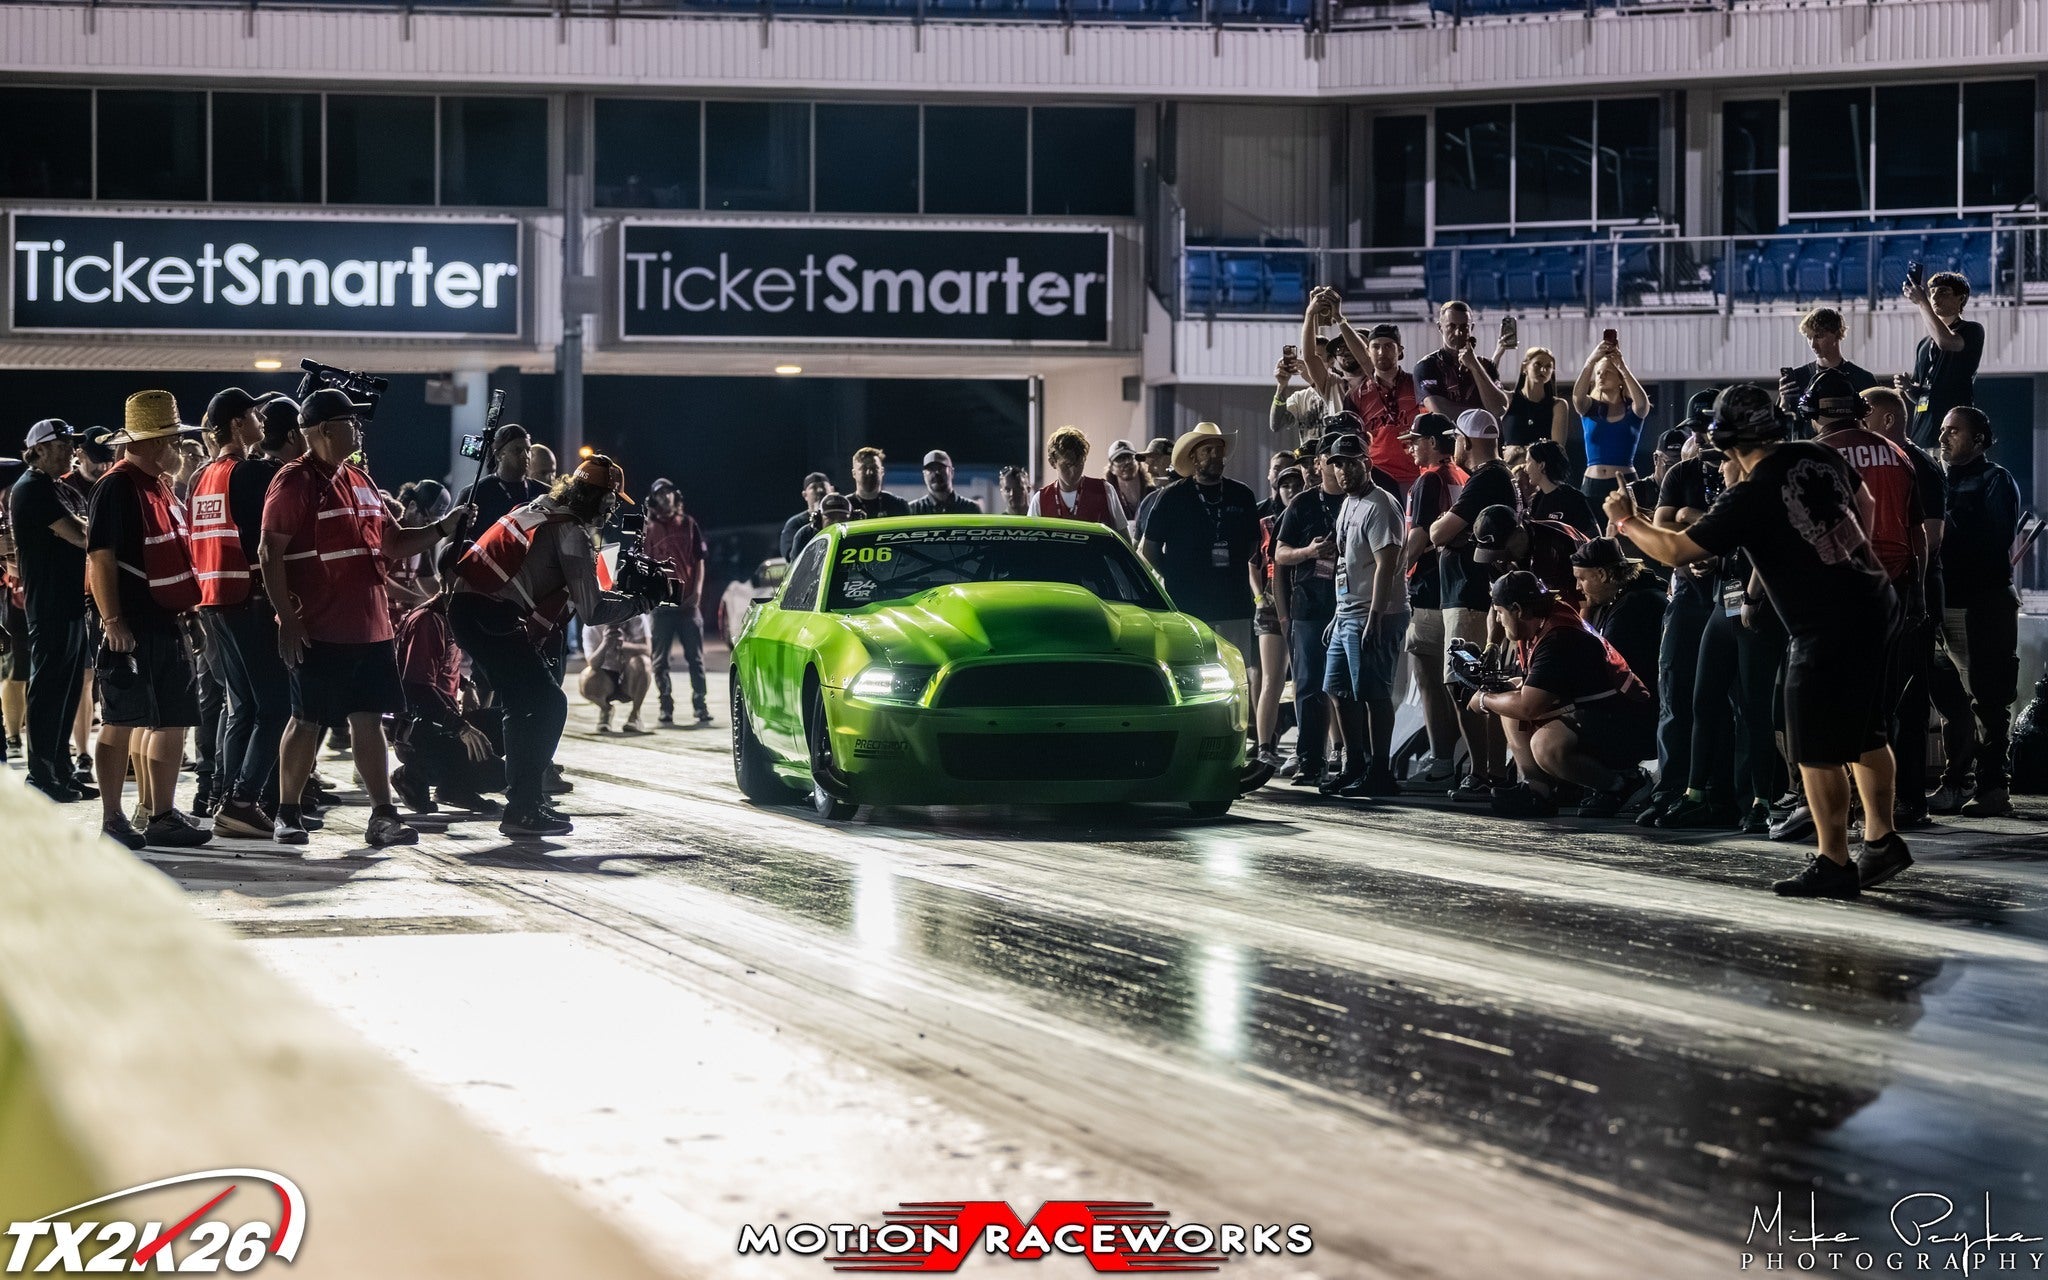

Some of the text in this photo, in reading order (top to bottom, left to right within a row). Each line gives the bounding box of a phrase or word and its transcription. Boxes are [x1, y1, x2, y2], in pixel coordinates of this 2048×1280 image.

[15, 239, 517, 309] TicketSmarter
[626, 250, 1105, 317] TicketSmarter
[196, 500, 222, 514] 1320
[876, 528, 1091, 542] FAST FORWARD
[923, 535, 966, 543] RACE
[841, 547, 892, 564] 206
